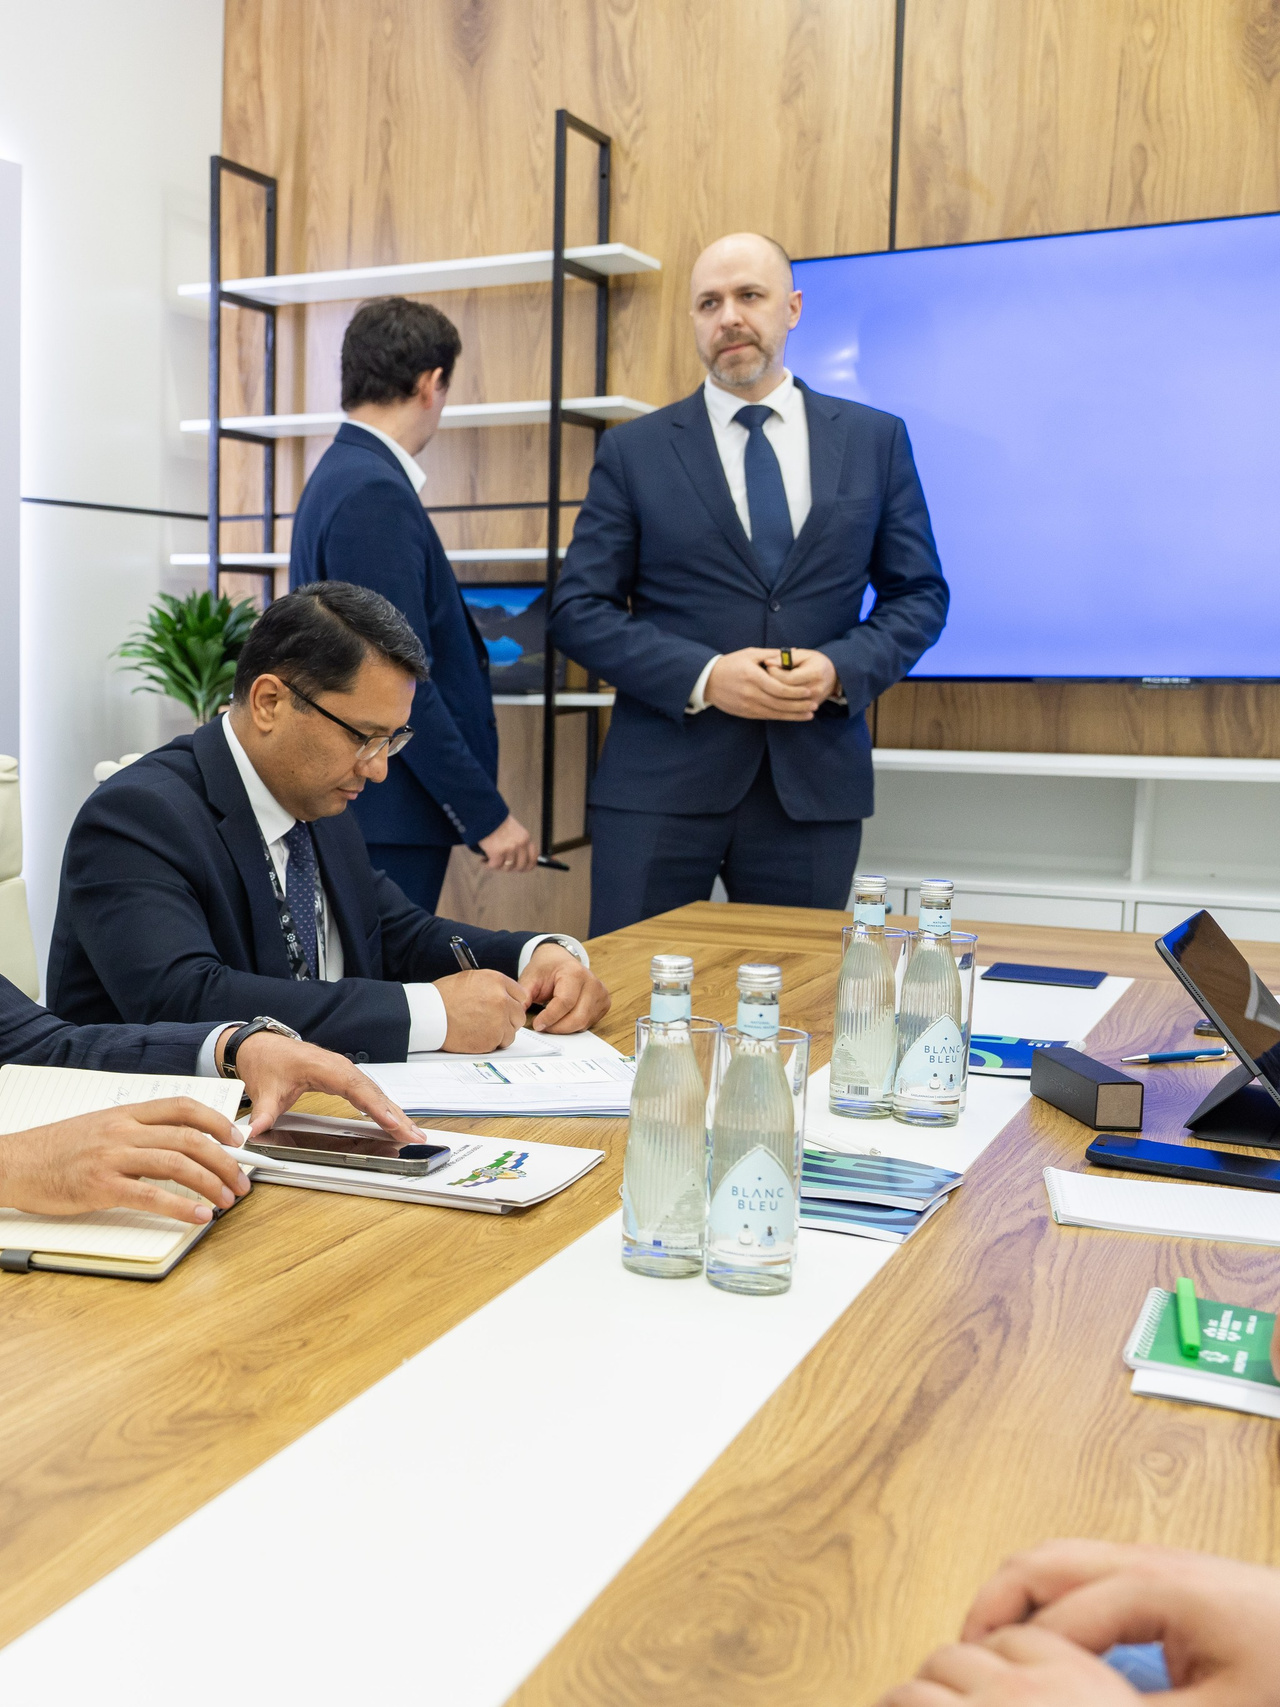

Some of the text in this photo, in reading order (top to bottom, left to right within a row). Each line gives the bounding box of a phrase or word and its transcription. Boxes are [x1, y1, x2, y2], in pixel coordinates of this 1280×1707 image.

[924, 1045, 960, 1054] BLANC
[929, 1055, 957, 1063] BLEU
[731, 1186, 784, 1198] BLANC
[737, 1199, 778, 1211] BLEU
